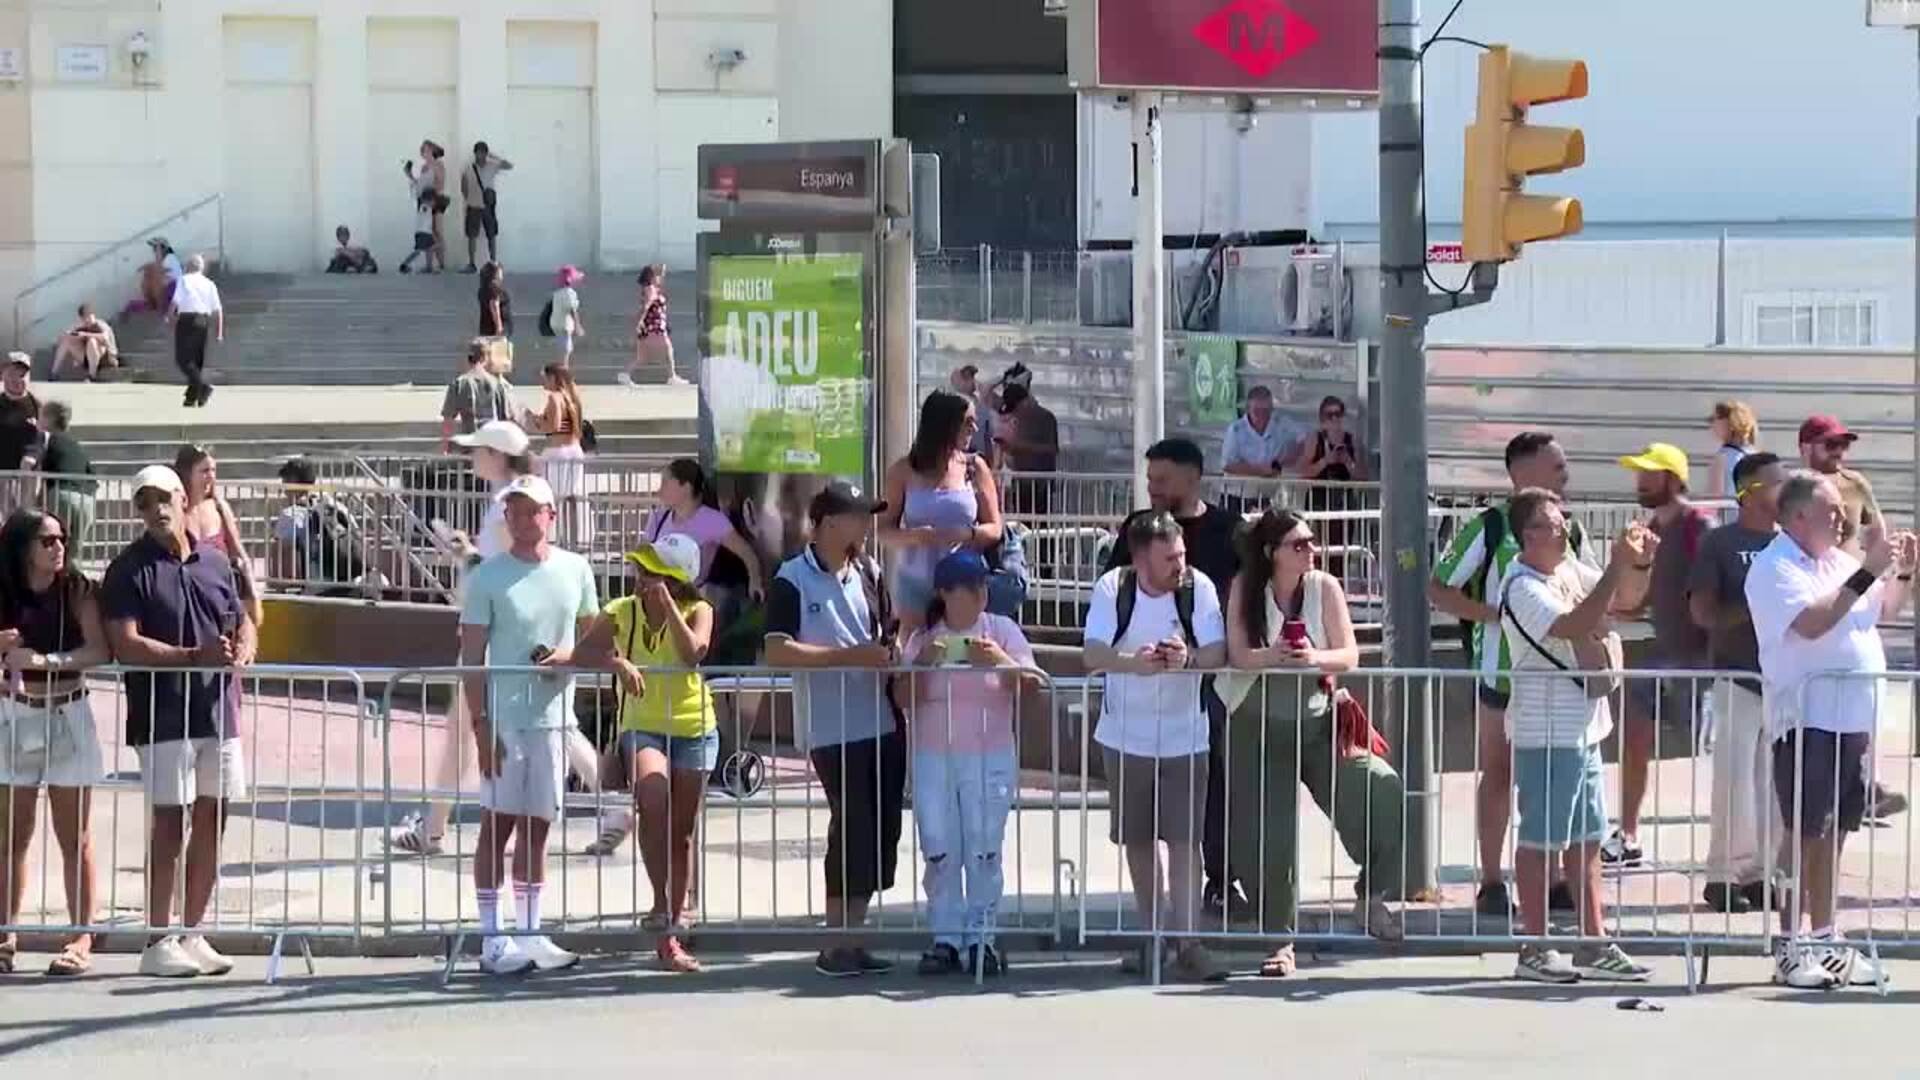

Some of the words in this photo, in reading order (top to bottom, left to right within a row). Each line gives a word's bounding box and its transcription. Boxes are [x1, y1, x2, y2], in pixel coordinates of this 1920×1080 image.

[1230, 11, 1284, 54] M
[801, 168, 854, 190] Espanya
[724, 311, 818, 376] ADEU
